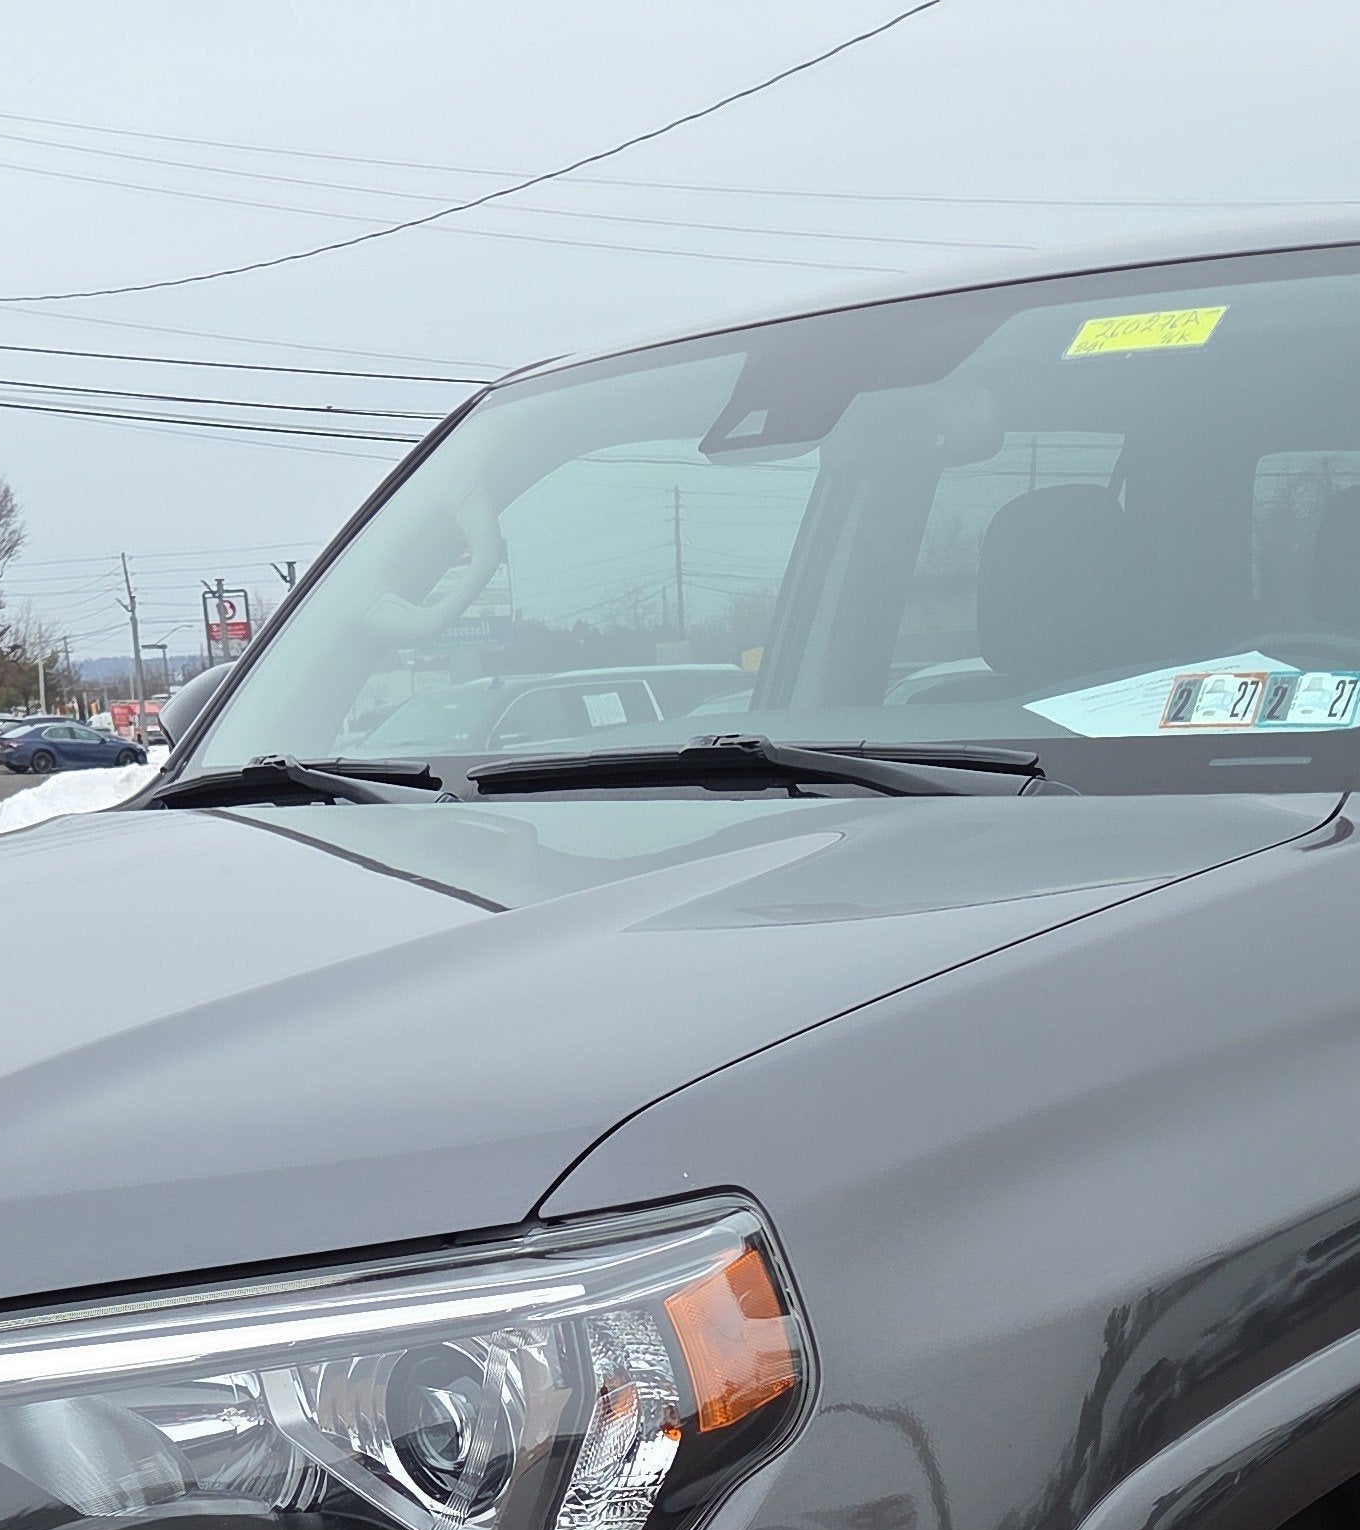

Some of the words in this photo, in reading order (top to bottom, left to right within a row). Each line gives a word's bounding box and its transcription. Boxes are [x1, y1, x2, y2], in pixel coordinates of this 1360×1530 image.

[1172, 687, 1191, 721] 2
[1229, 680, 1260, 721] 27
[1266, 685, 1288, 720] 2
[1327, 679, 1359, 721] 27
